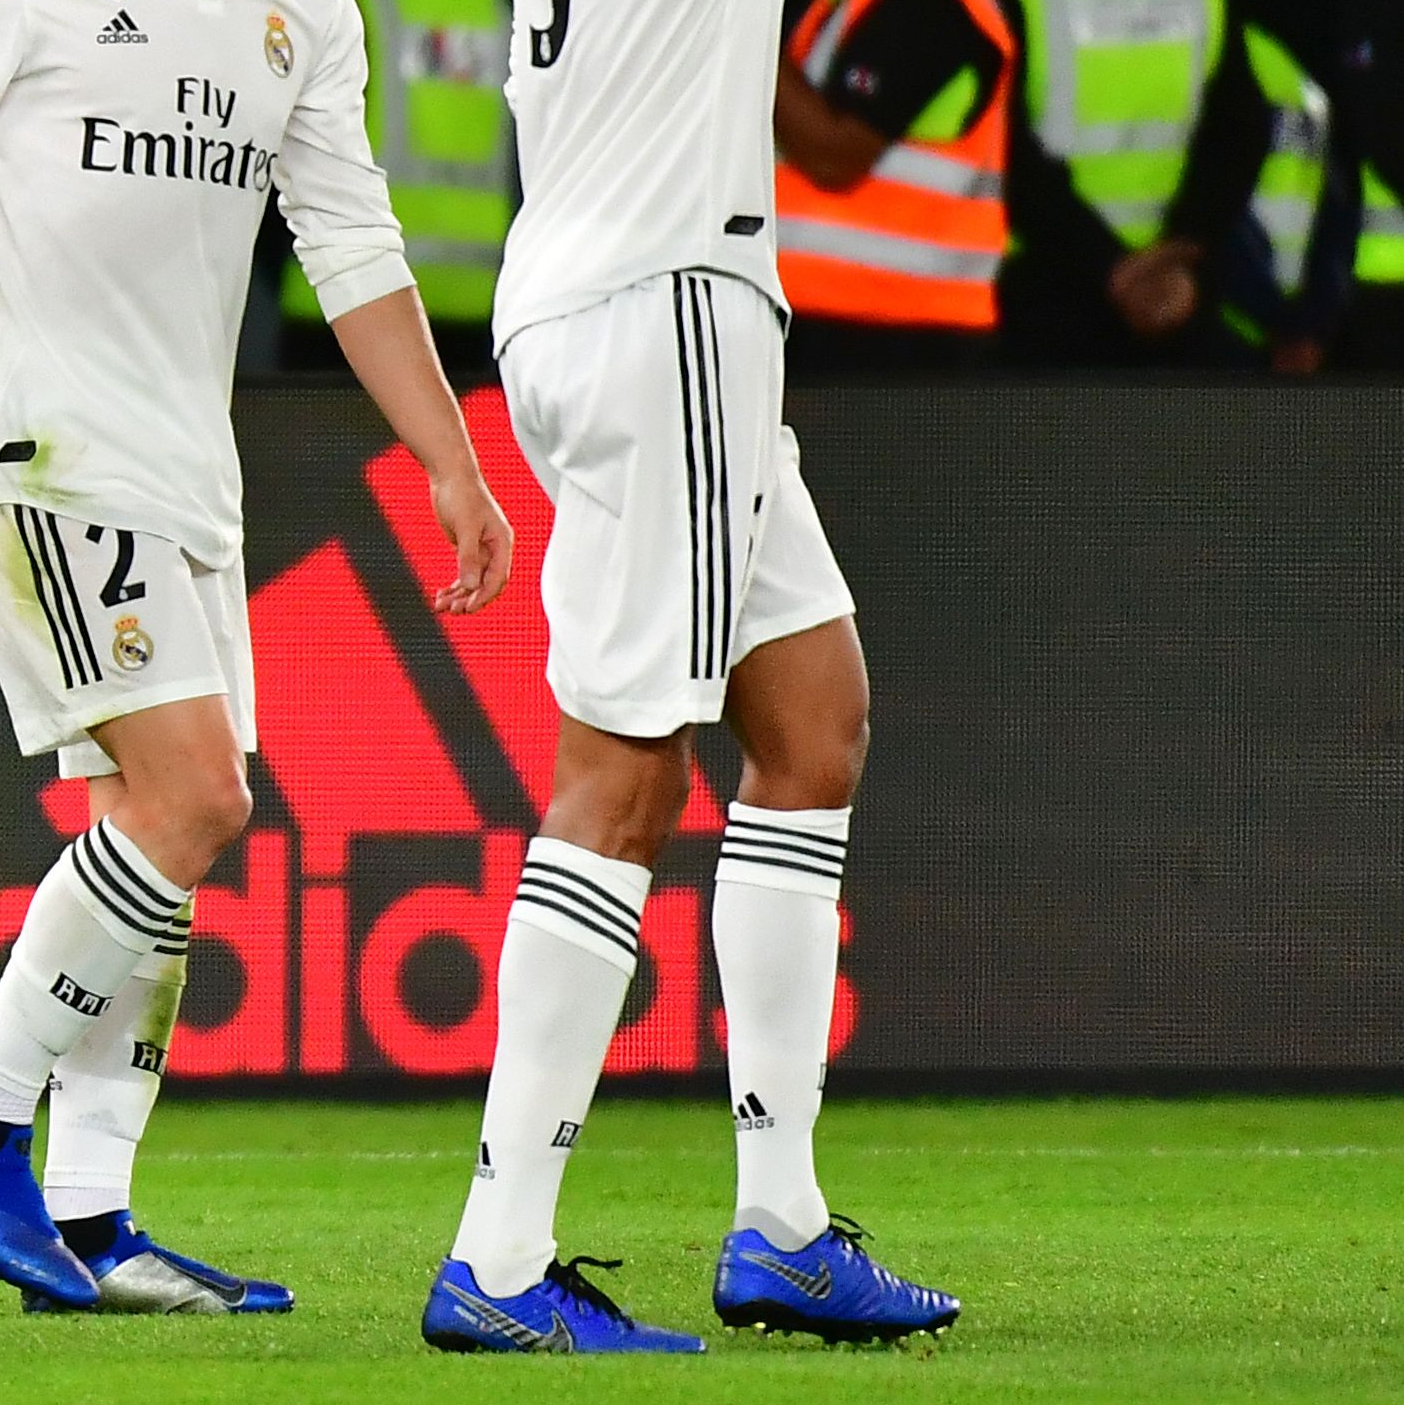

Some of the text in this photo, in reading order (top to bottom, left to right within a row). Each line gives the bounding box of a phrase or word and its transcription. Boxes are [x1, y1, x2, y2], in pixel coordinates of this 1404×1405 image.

[96, 30, 149, 45] adidas
[176, 77, 237, 128] Fly
[84, 524, 146, 609] 2
